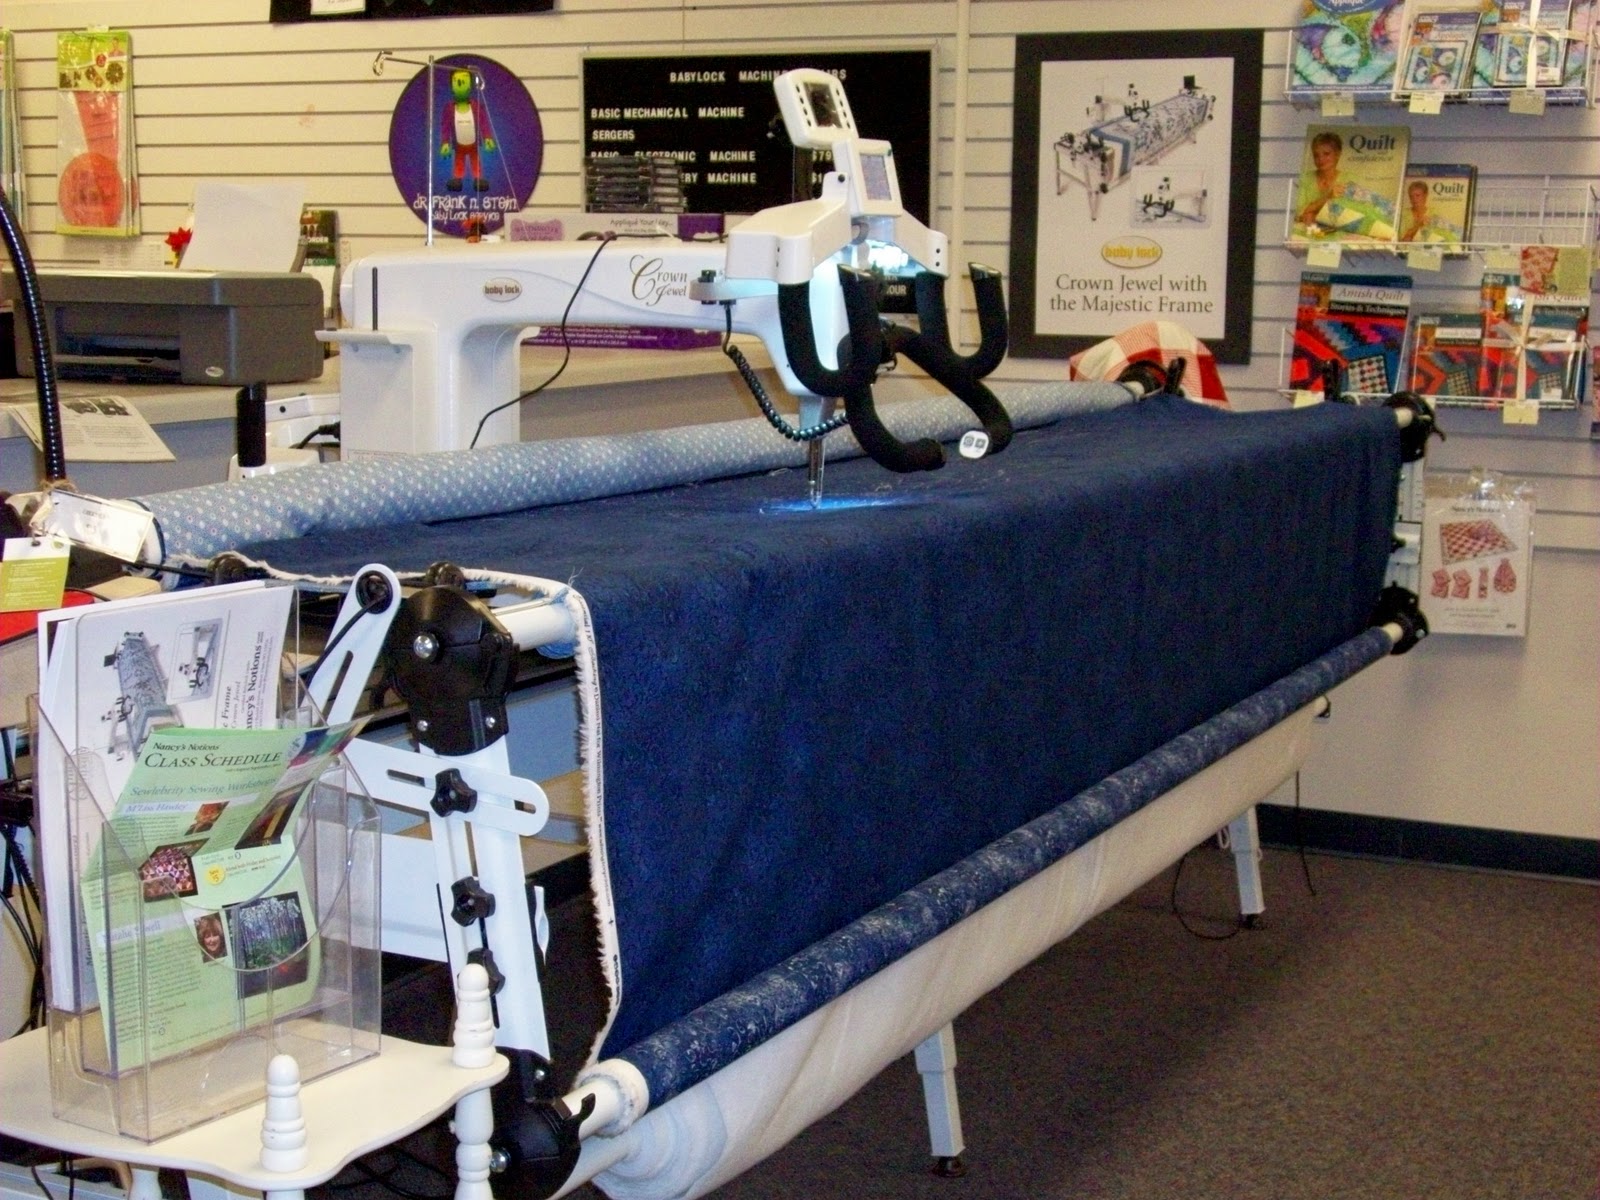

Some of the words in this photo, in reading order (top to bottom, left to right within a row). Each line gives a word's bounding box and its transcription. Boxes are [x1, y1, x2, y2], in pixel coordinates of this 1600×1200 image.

[669, 71, 726, 83] BABYLOCK
[590, 107, 621, 119] BASIC
[623, 106, 688, 119] MECHANICAL
[697, 106, 745, 118] MACHINE
[592, 129, 636, 141] SERGERS
[1350, 134, 1395, 154] Quilt
[709, 150, 757, 161] MACHINE
[706, 172, 758, 184] MACHINE
[1432, 182, 1464, 196] Quilt
[629, 254, 688, 301] Crown
[1056, 274, 1114, 291] Crown
[1119, 274, 1163, 292] Jewel
[1168, 275, 1208, 292] with
[484, 284, 503, 295] baby
[504, 284, 520, 294] lock
[646, 284, 687, 306] Jewel
[886, 284, 907, 295] OUR
[1337, 288, 1373, 298] Amish
[1375, 289, 1405, 301] Quilt
[1050, 294, 1077, 311] the
[1082, 295, 1153, 315] Majestic
[1158, 296, 1214, 313] Frame
[247, 644, 262, 692] Notions
[246, 694, 256, 730] ancy's
[152, 742, 186, 752] Nancy's
[187, 743, 220, 751] Notions
[144, 752, 197, 768] CLASS
[200, 752, 283, 767] SCHEDULE
[189, 784, 225, 795] Sewing
